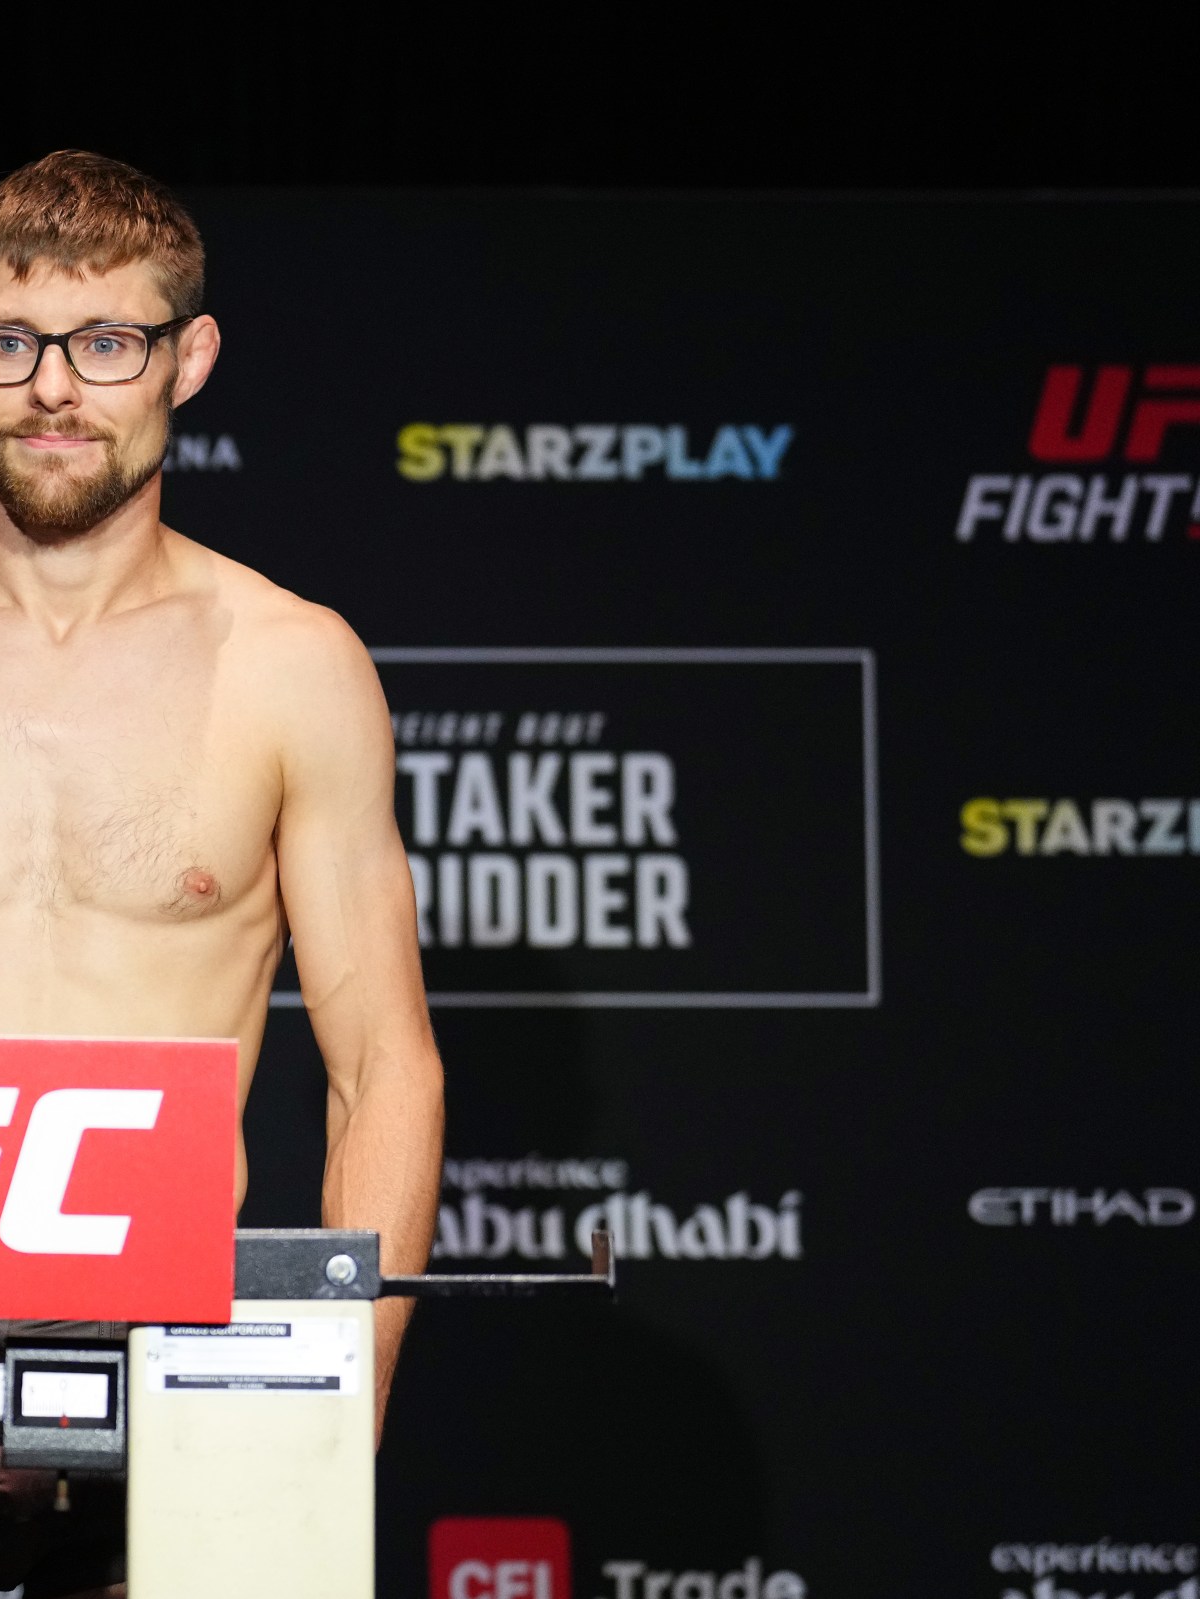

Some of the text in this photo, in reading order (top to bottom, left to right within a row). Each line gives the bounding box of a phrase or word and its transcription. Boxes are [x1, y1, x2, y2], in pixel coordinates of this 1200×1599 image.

[1028, 365, 1200, 463] UF
[397, 423, 793, 481] STARZPLAY
[956, 474, 1191, 543] FIGHT
[392, 712, 502, 745] EIGHT
[398, 751, 677, 846] TAKER
[575, 1191, 802, 1260] dhabi
[967, 1187, 1196, 1226] ETIHAD
[600, 1557, 807, 1599] Trade
